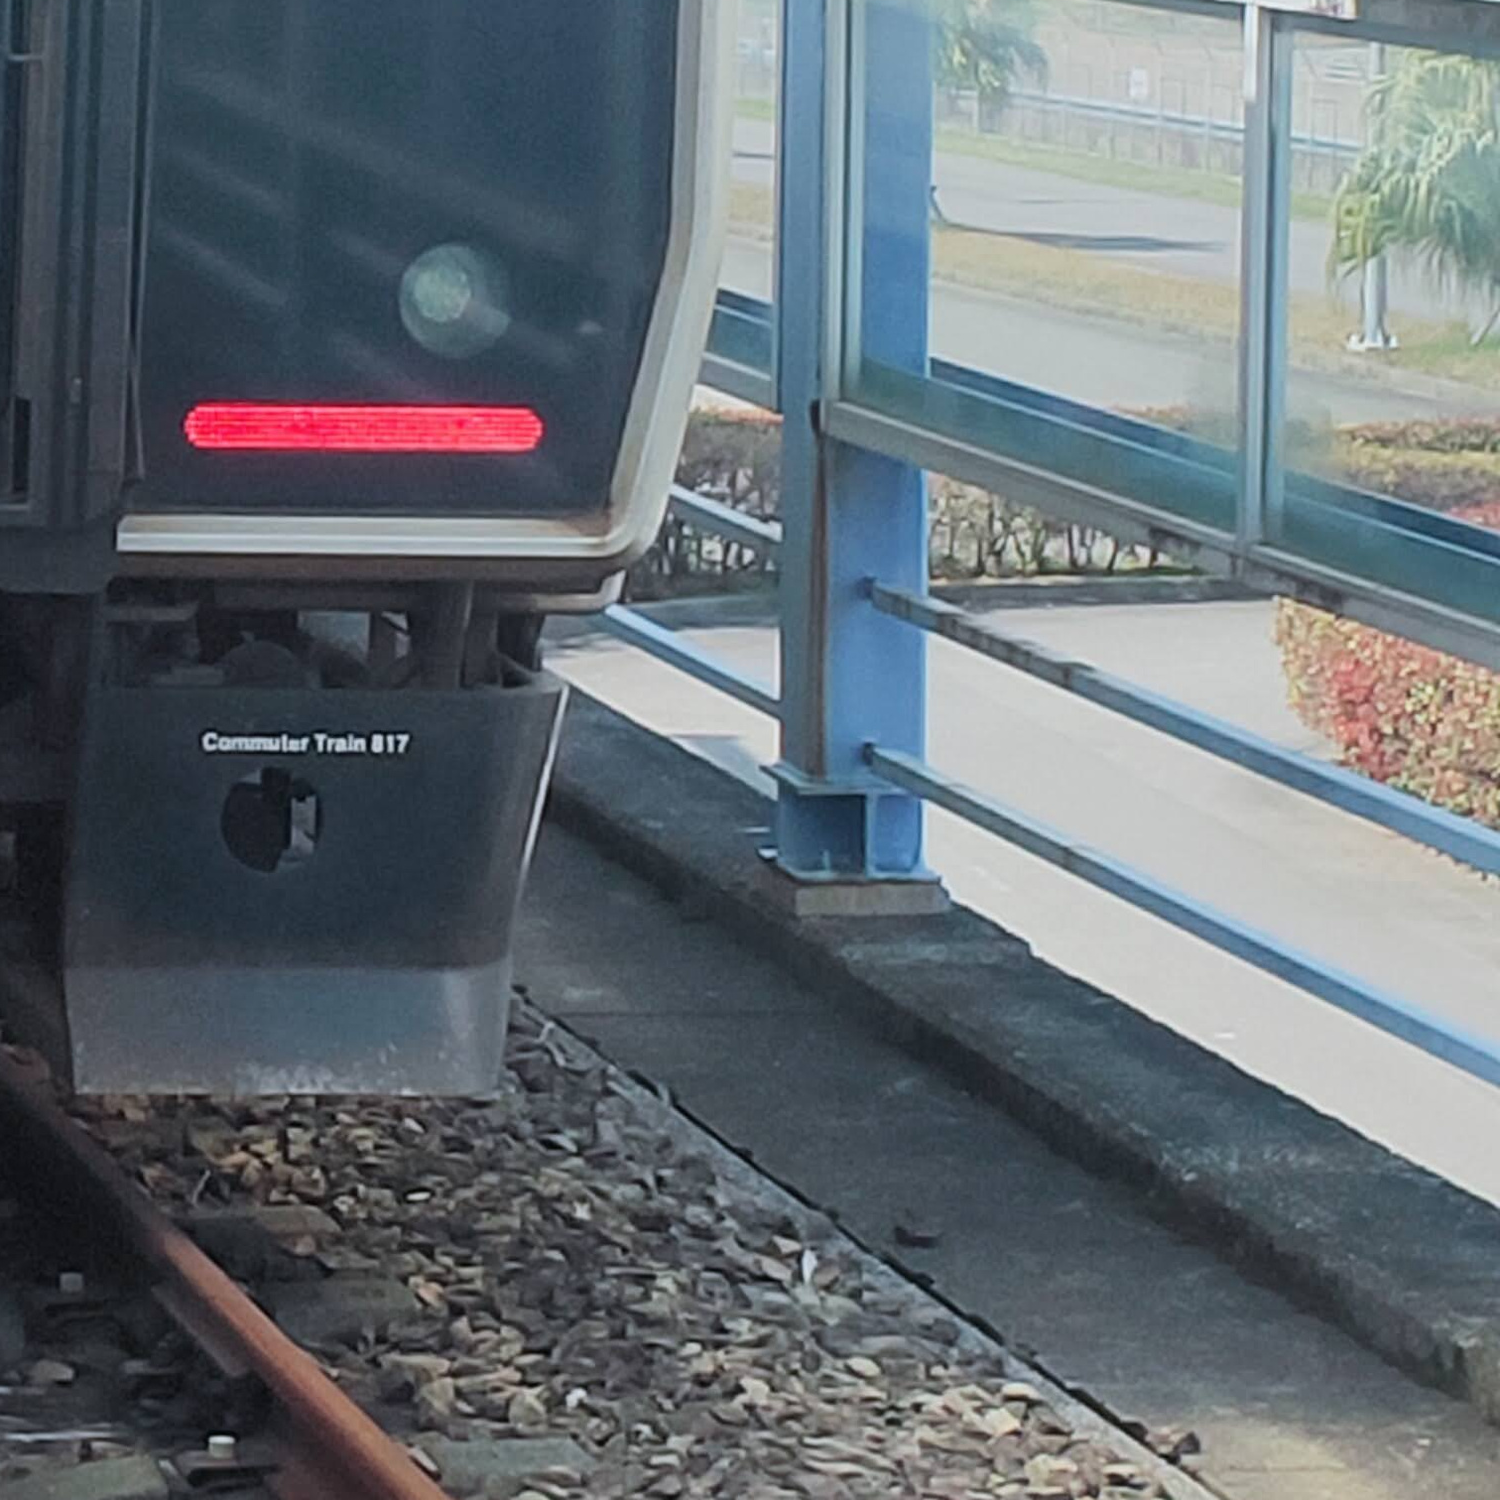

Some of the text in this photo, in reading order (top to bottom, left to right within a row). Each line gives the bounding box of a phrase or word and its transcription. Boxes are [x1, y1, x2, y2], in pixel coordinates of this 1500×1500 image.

[201, 731, 410, 754] Commuter Train 817
